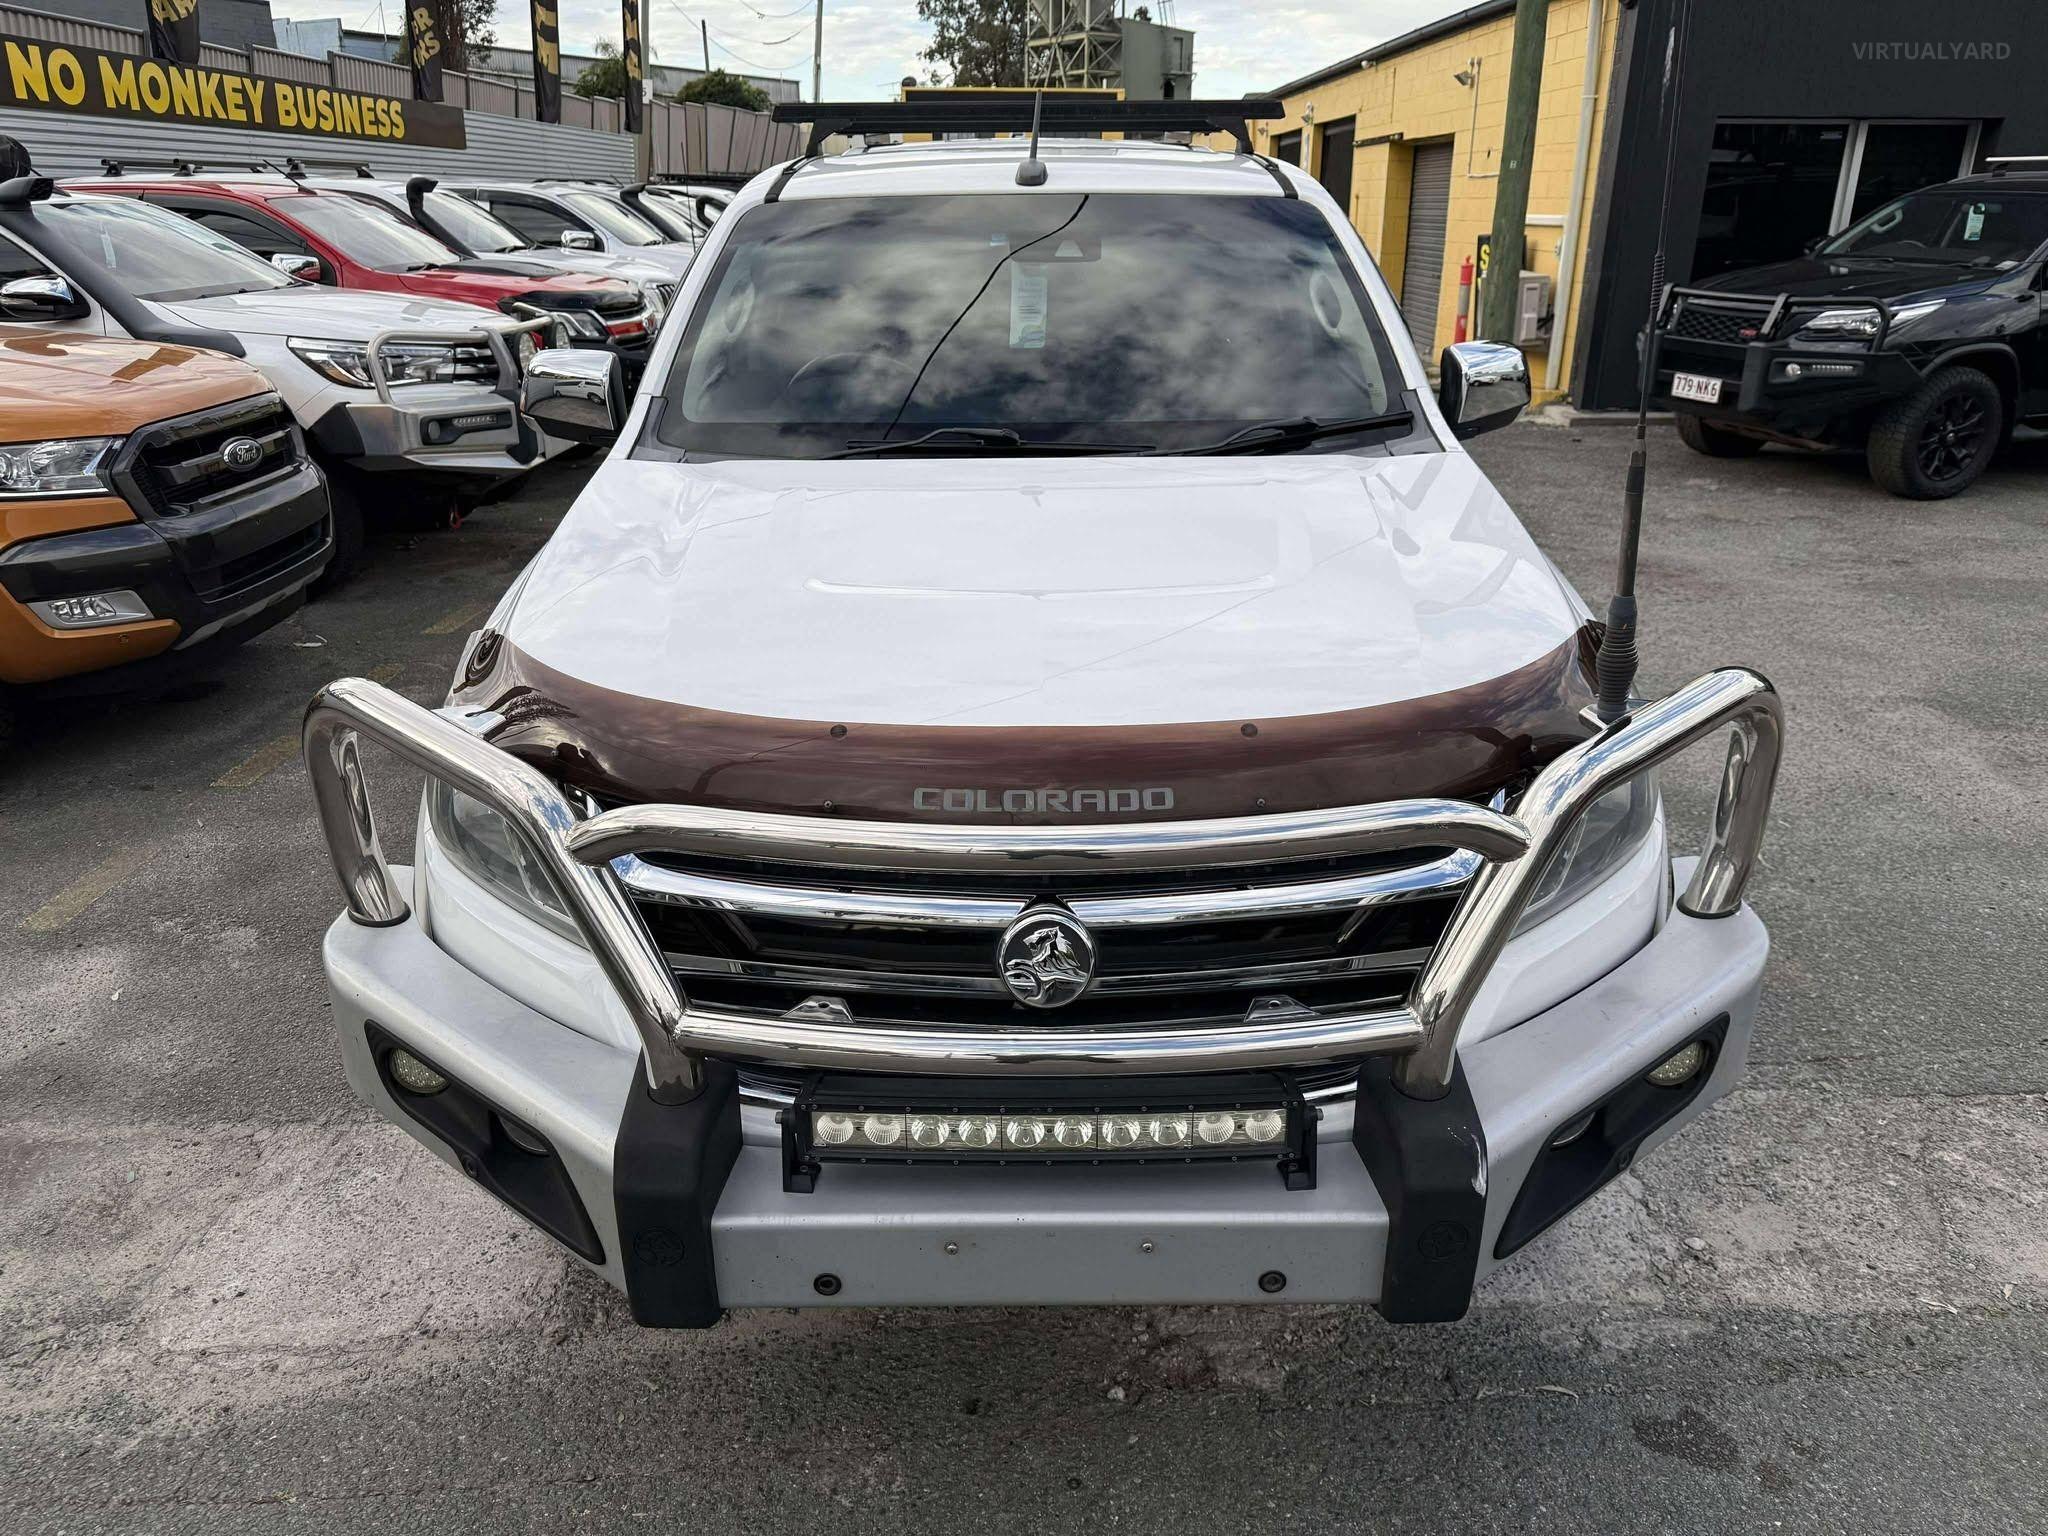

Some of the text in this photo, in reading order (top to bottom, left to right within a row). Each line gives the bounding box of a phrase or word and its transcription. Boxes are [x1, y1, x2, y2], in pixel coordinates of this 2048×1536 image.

[4, 41, 406, 140] NO MONKEY BUSINESS
[236, 444, 258, 463] Ford
[913, 787, 1175, 813] COLORADO
